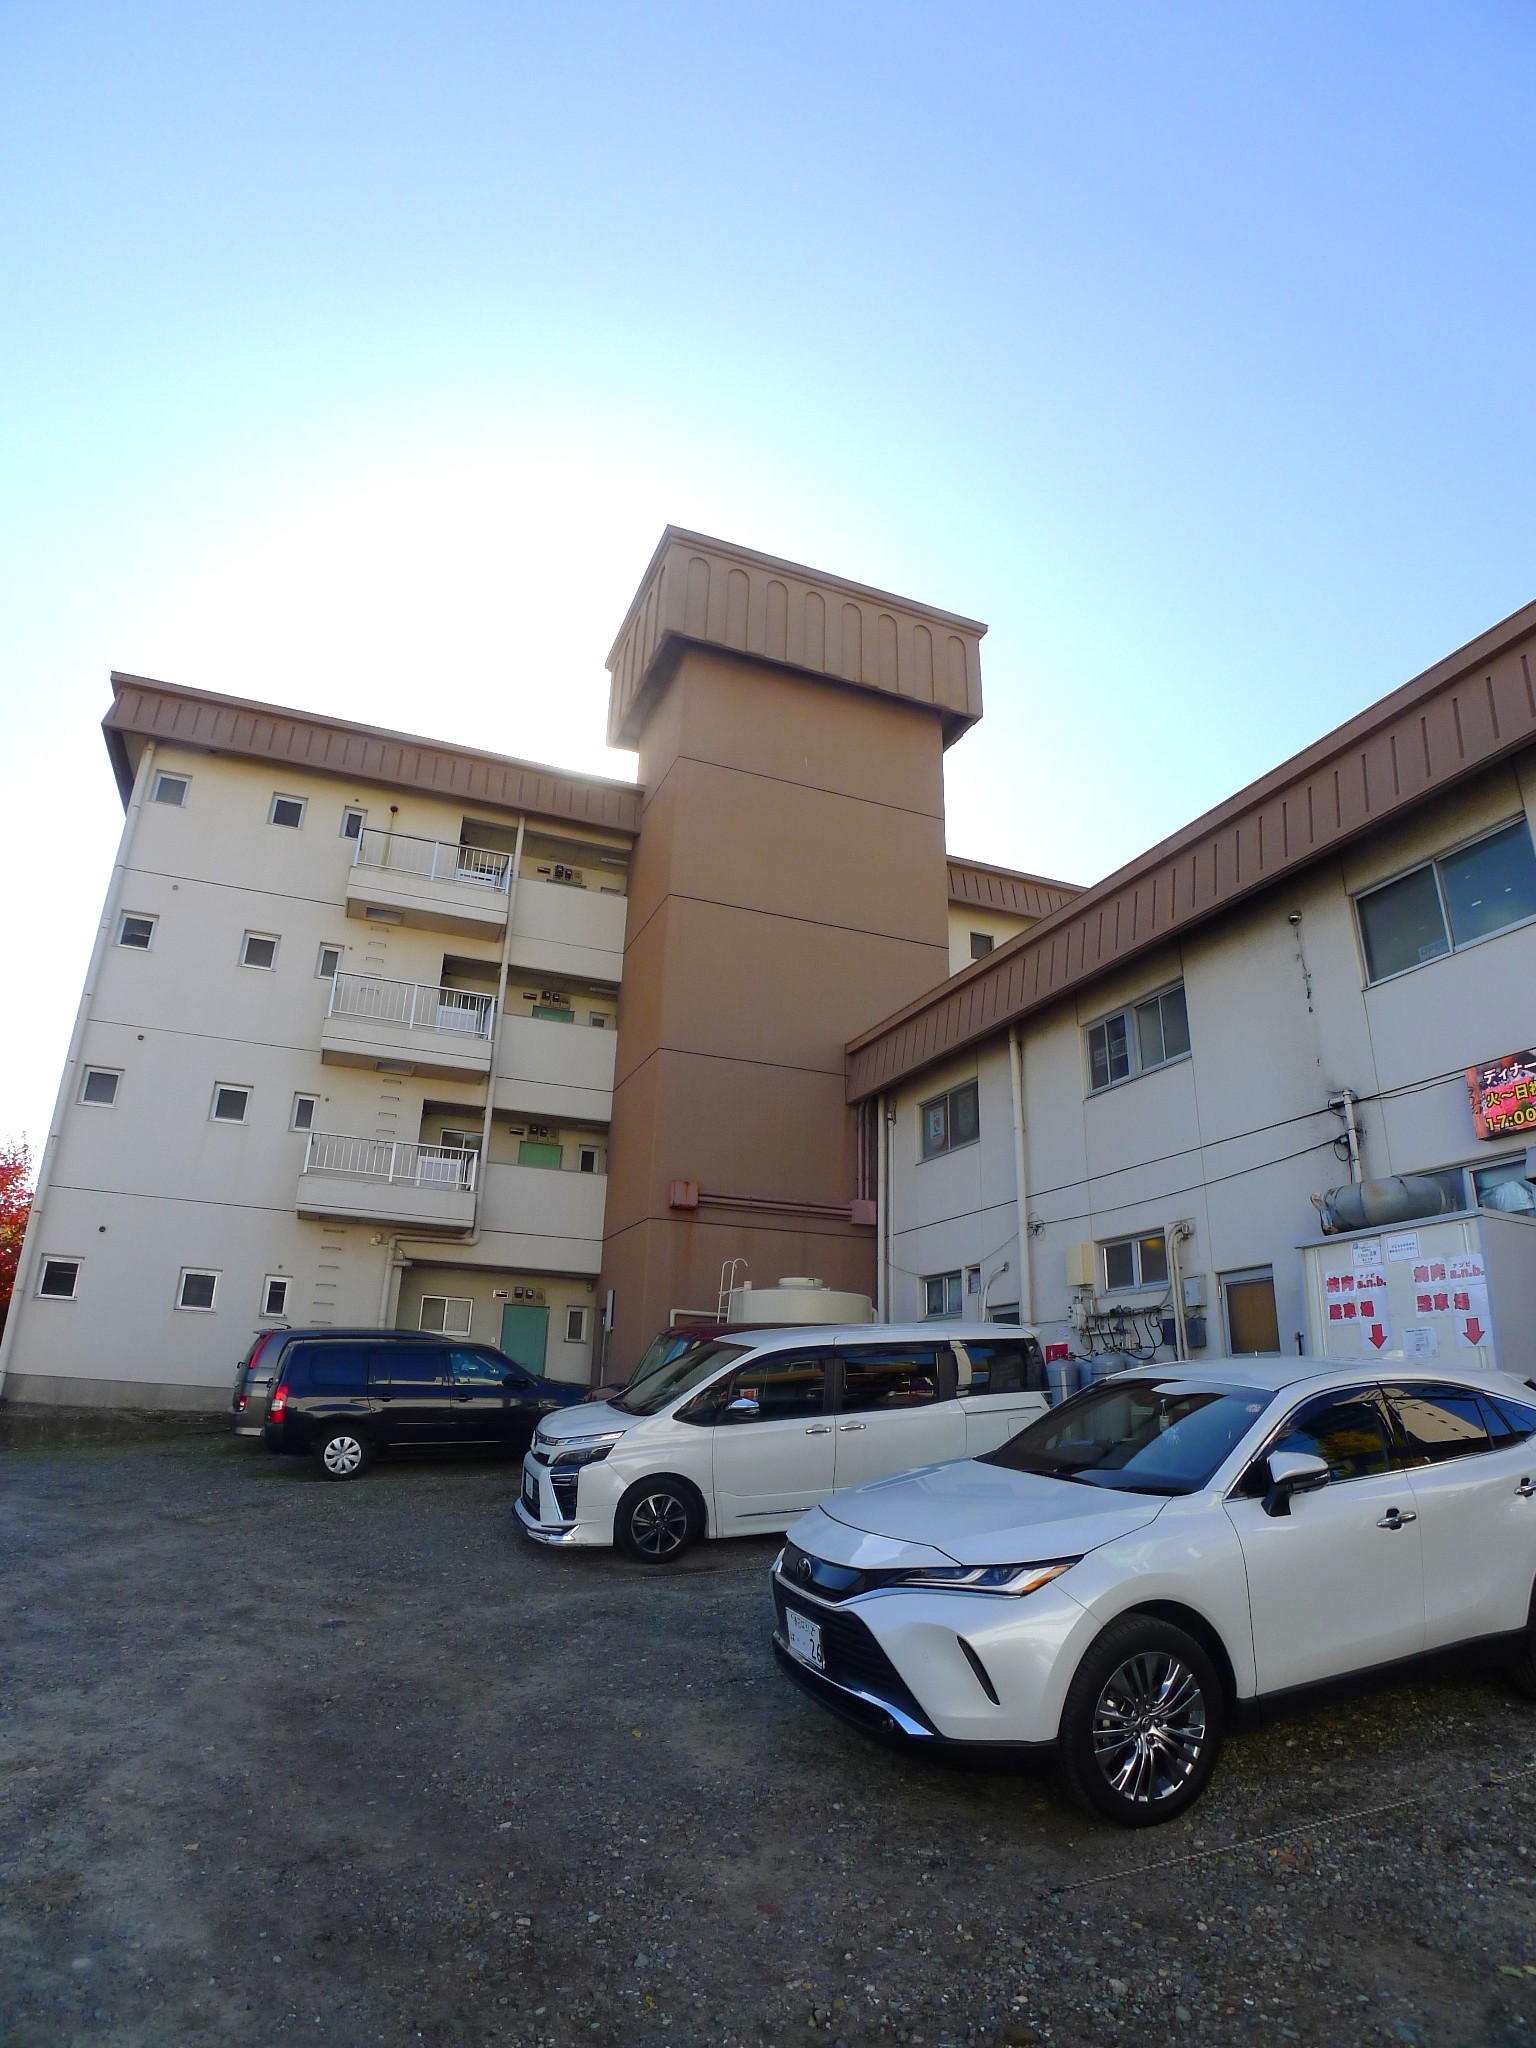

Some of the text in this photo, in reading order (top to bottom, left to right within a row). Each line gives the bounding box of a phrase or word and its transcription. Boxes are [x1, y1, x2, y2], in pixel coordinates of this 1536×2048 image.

[1413, 1263, 1446, 1282] 焼肉
[1327, 1275, 1354, 1293] 焼肉
[1329, 1301, 1374, 1320] 駐車場
[1417, 1292, 1470, 1312] 駐車場
